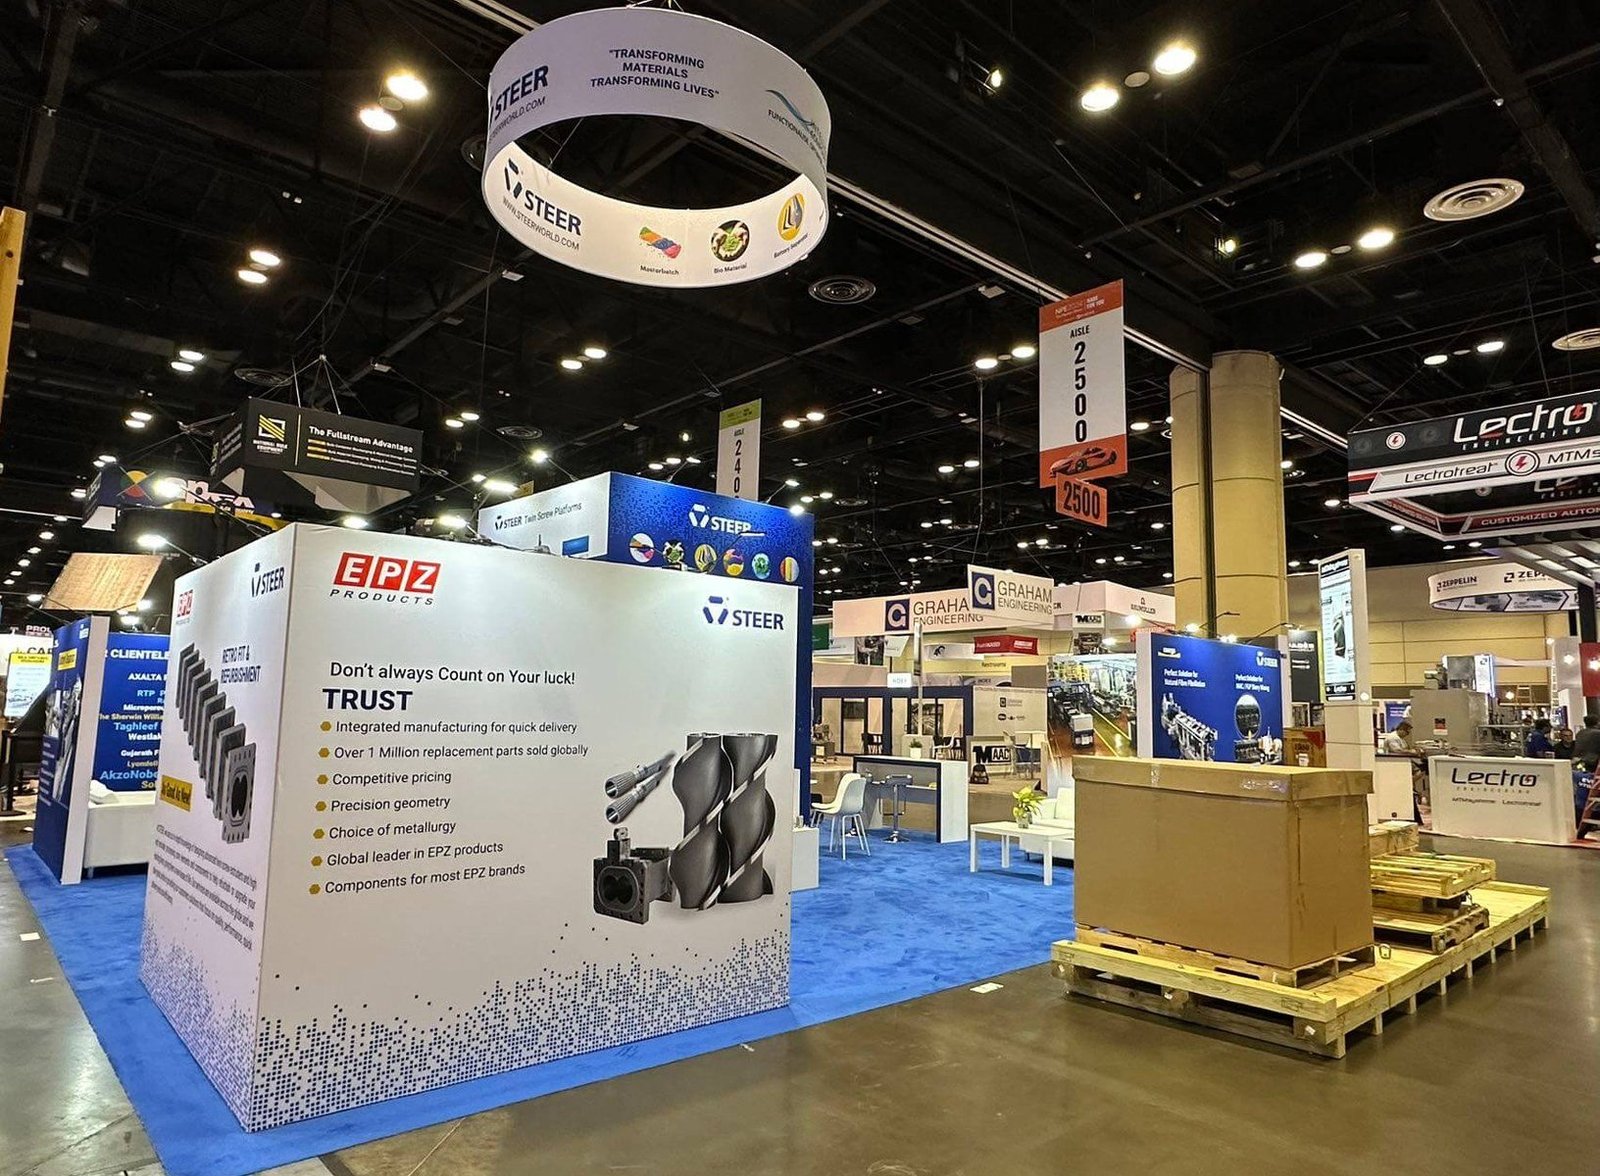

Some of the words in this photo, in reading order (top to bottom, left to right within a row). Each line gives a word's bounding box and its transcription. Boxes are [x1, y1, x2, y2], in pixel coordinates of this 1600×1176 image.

[622, 62, 688, 78] MATERIALS
[495, 65, 548, 120] STEER
[590, 76, 680, 90] TRANSFORMING
[502, 196, 580, 250] WWW.STEERWORLD.COM
[524, 190, 582, 236] STEER
[1070, 324, 1090, 338] AISLE
[1074, 341, 1087, 442] 2500
[1454, 402, 1594, 443] Lectro
[309, 426, 324, 436] The
[326, 429, 371, 444] Fullstream
[372, 438, 414, 454] Advantage
[1462, 426, 1582, 450] ENGINEERING
[734, 440, 742, 498] 240
[1404, 462, 1492, 484] Lectrotreat
[1063, 480, 1100, 520] 2500
[504, 516, 522, 530] STEER
[554, 502, 582, 518] Platforms
[1481, 512, 1558, 526] CUSTOMIZED
[260, 566, 285, 595] STEER
[340, 556, 438, 590] EPZ
[1442, 576, 1478, 589] ZEPPELIN
[330, 588, 434, 606] PRODUCTS
[997, 580, 1052, 604] GRAHAM
[912, 597, 970, 616] GRAHA
[997, 597, 1052, 615] ENGINEERING
[732, 609, 784, 630] STEER
[128, 672, 162, 680] AXALTA
[378, 664, 434, 683] always
[438, 667, 482, 682] Count
[486, 671, 505, 682] on
[508, 670, 540, 684] Your
[544, 670, 575, 685] luck!
[322, 688, 413, 710] TRUST
[114, 722, 158, 732] Taghleef
[128, 732, 162, 740] Westlak
[336, 721, 400, 734] Integrated
[404, 722, 488, 734] manufacturing
[491, 722, 506, 732] for
[508, 722, 536, 734] quick
[539, 722, 578, 734] delivery
[334, 747, 364, 758] Over
[368, 747, 374, 758] 1
[379, 746, 420, 758] Million
[423, 746, 493, 760] replacement
[496, 746, 524, 759] parts
[526, 745, 548, 756] sold
[550, 744, 588, 757] globally
[332, 772, 408, 786] Competitive
[412, 772, 452, 784] pricing
[1452, 768, 1537, 787] Lectro
[331, 799, 390, 812] Precision
[394, 797, 450, 812] geometry
[329, 825, 374, 840] Choice
[377, 824, 391, 836] of
[394, 822, 456, 836] metallurgy
[327, 851, 369, 866] Global
[372, 849, 410, 863] leader
[414, 848, 424, 860] in
[428, 846, 451, 858] EPZ
[454, 842, 504, 857] products
[325, 876, 407, 894] Components
[410, 872, 427, 886] for
[430, 870, 460, 883] most
[463, 868, 486, 879] EPZ
[489, 864, 526, 877] brands
